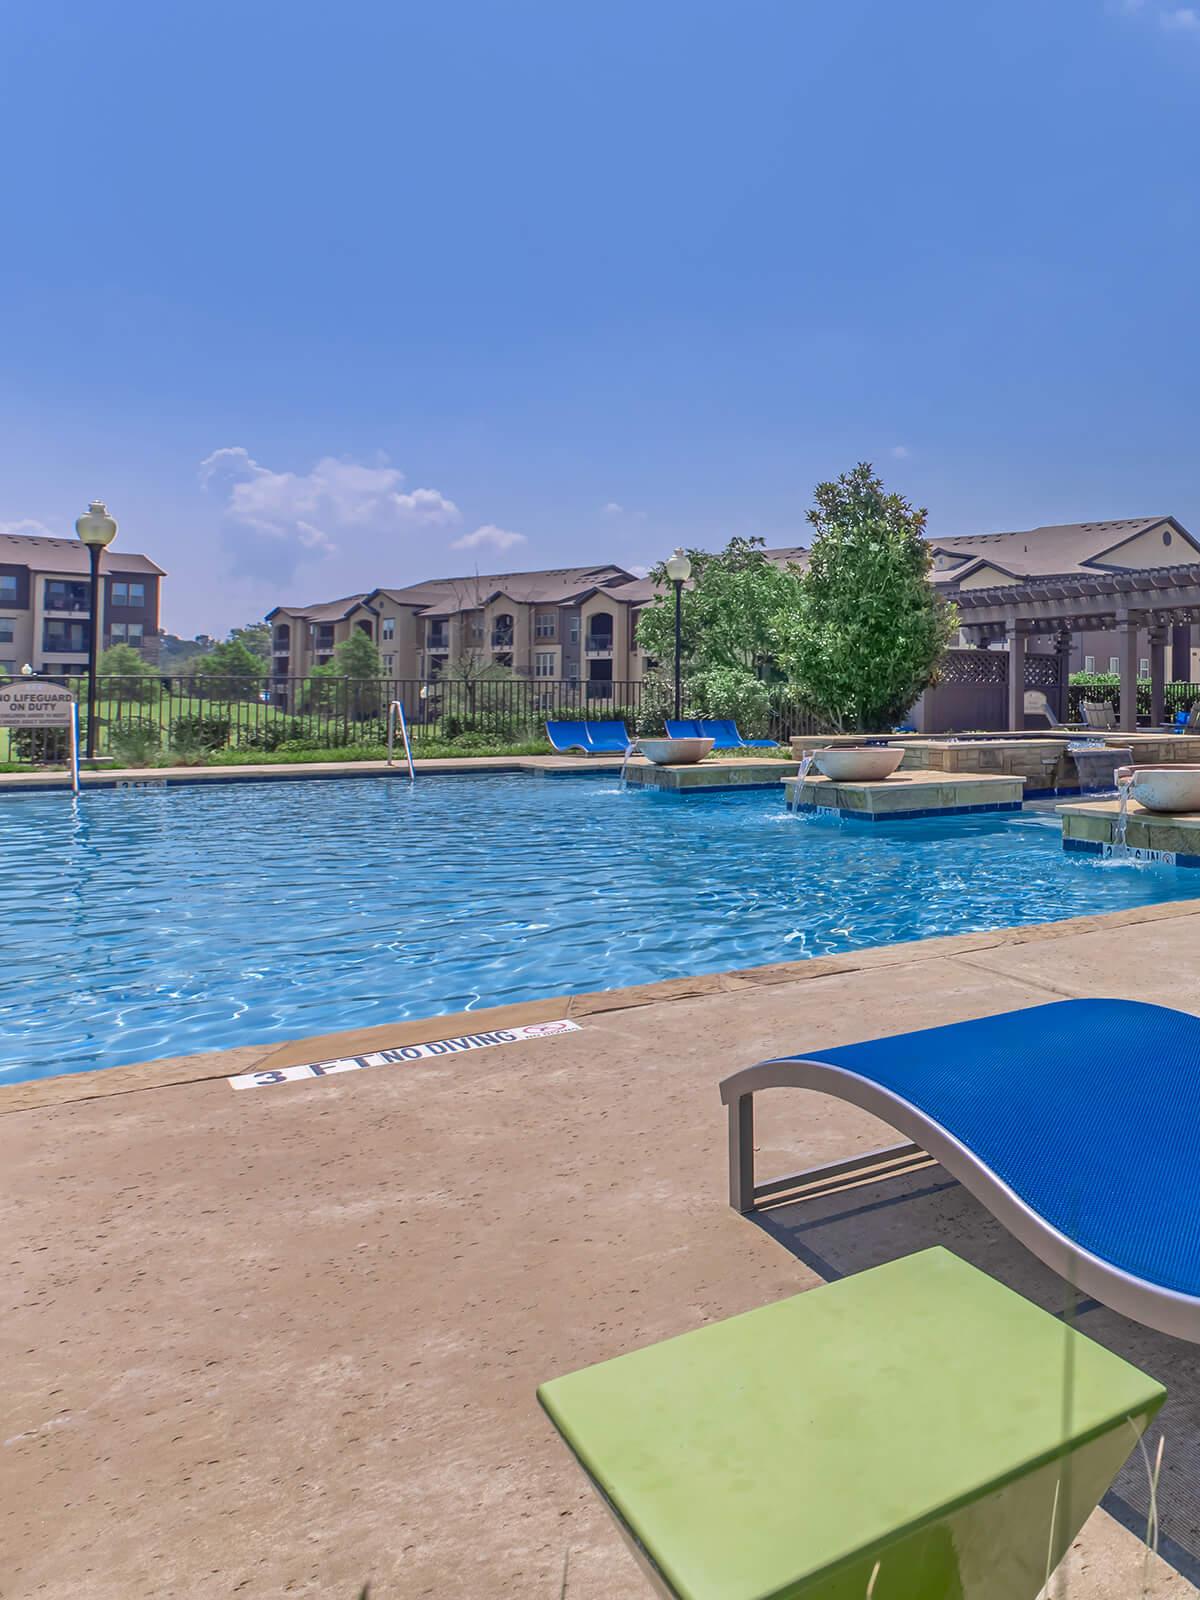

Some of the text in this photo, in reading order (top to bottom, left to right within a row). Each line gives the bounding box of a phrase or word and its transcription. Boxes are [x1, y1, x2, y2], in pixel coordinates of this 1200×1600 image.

[14, 694, 72, 702] LIFEGUARD
[10, 703, 57, 711] ON DUTY
[254, 1070, 288, 1086] 3
[308, 1054, 375, 1077] FT
[380, 1047, 423, 1063] NO
[425, 1031, 518, 1055] DIVING
